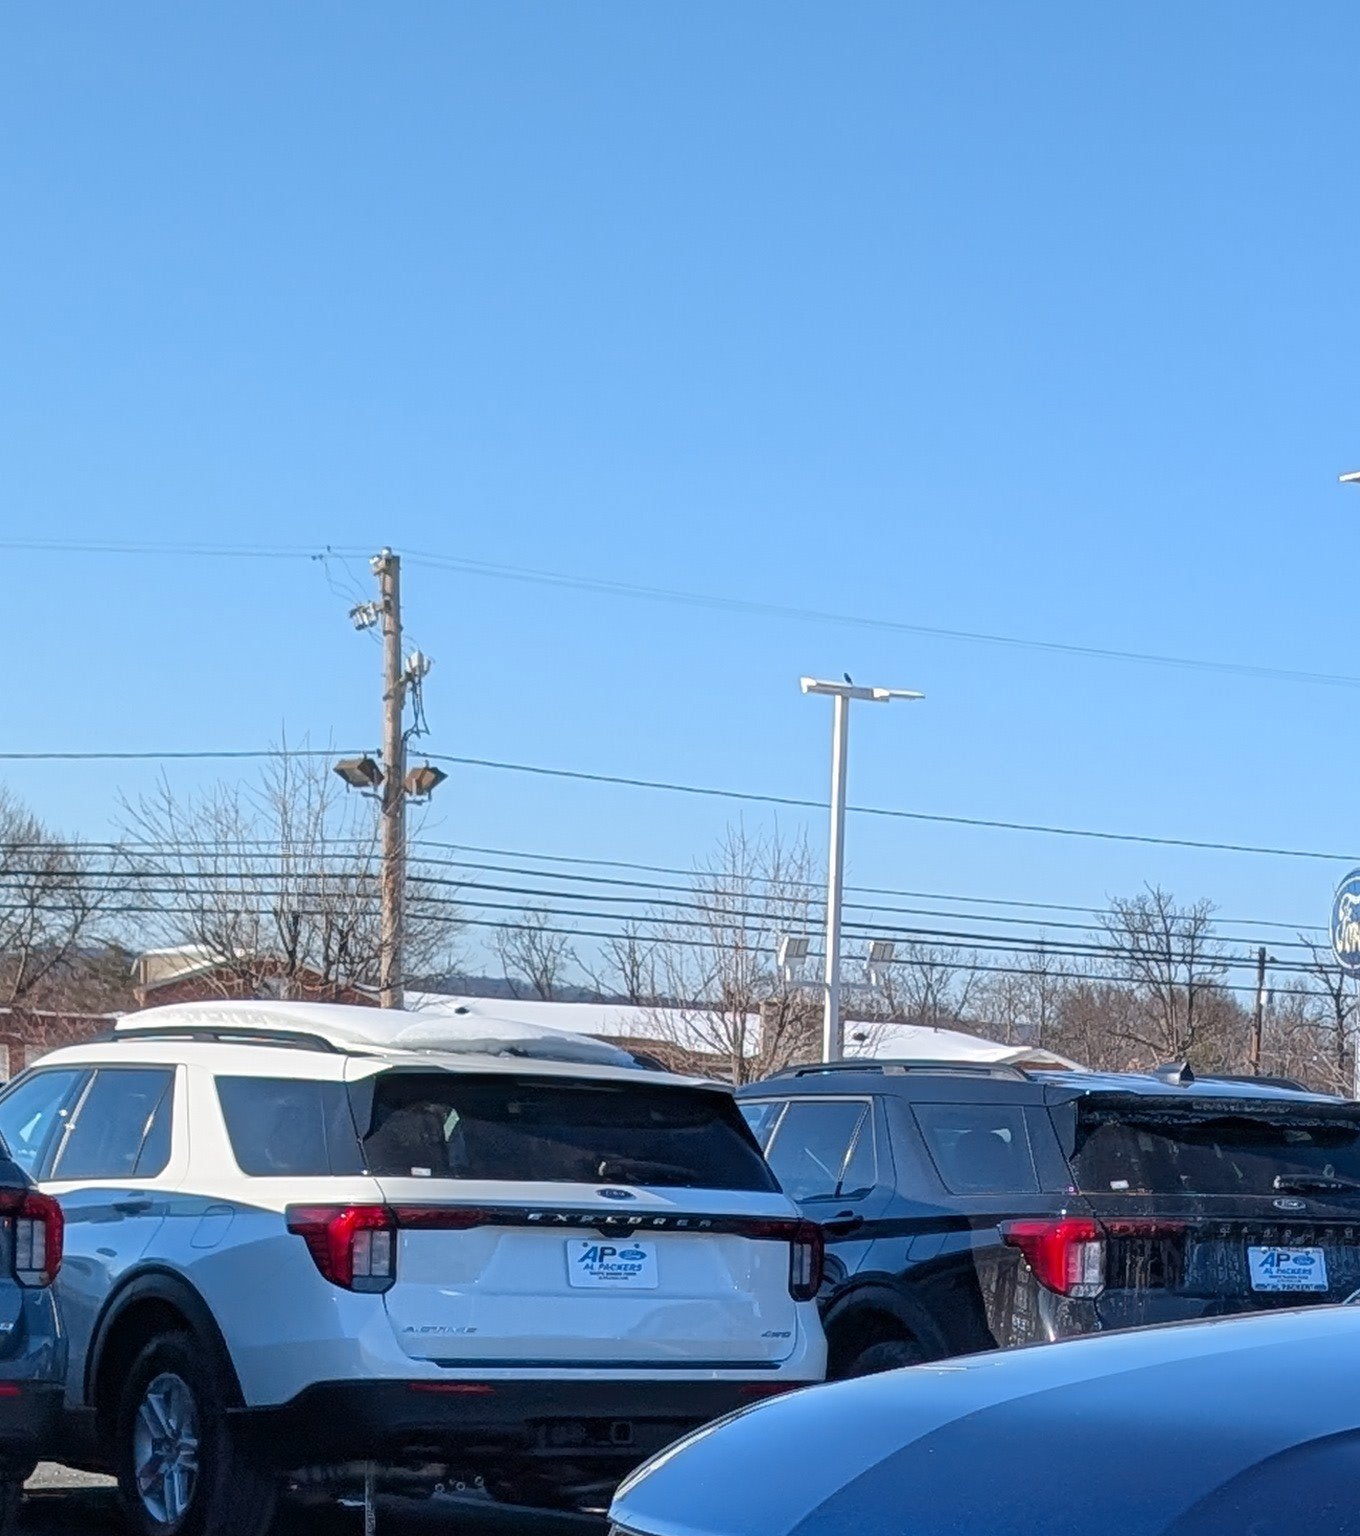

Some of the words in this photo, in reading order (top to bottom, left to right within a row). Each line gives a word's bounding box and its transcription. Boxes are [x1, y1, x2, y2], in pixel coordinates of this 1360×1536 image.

[527, 1212, 712, 1228] EXPLORER
[578, 1246, 617, 1263] AP
[1259, 1252, 1291, 1267] AP
